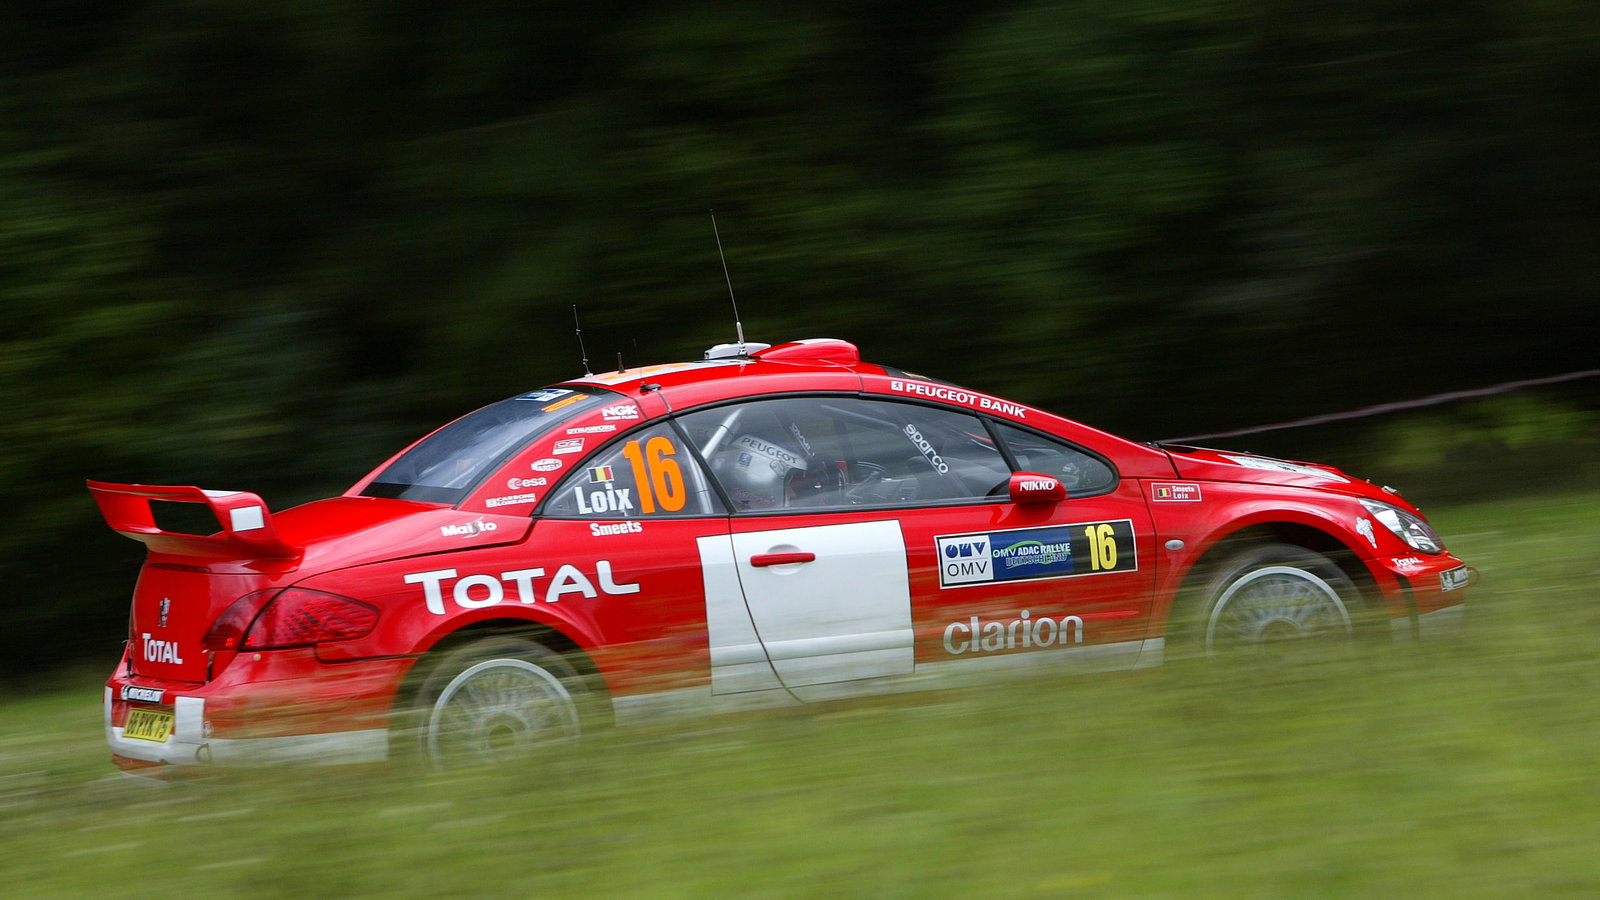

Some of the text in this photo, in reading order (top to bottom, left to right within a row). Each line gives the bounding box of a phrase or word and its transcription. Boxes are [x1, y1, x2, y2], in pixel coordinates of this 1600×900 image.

[601, 405, 638, 417] NGK
[905, 382, 1027, 419] PEUGEOT BANK
[741, 437, 798, 464] PEUGEOT
[904, 423, 949, 475] sparco
[522, 477, 547, 487] esa
[623, 436, 686, 514] 16
[1019, 480, 1056, 491] NIKKO
[574, 483, 634, 514] Loix
[1171, 485, 1195, 493] Smeets
[1172, 491, 1189, 499] Loix
[440, 518, 498, 539] Maisto
[590, 521, 643, 537] Smeets
[992, 543, 1071, 558] OMV ADAC RALLYE
[1084, 523, 1118, 571] 16
[947, 561, 988, 577] OMV
[1390, 557, 1424, 567] TOTAL
[403, 560, 641, 615] TOTAL
[943, 609, 1083, 655] clarion
[142, 633, 183, 664] TOTAL
